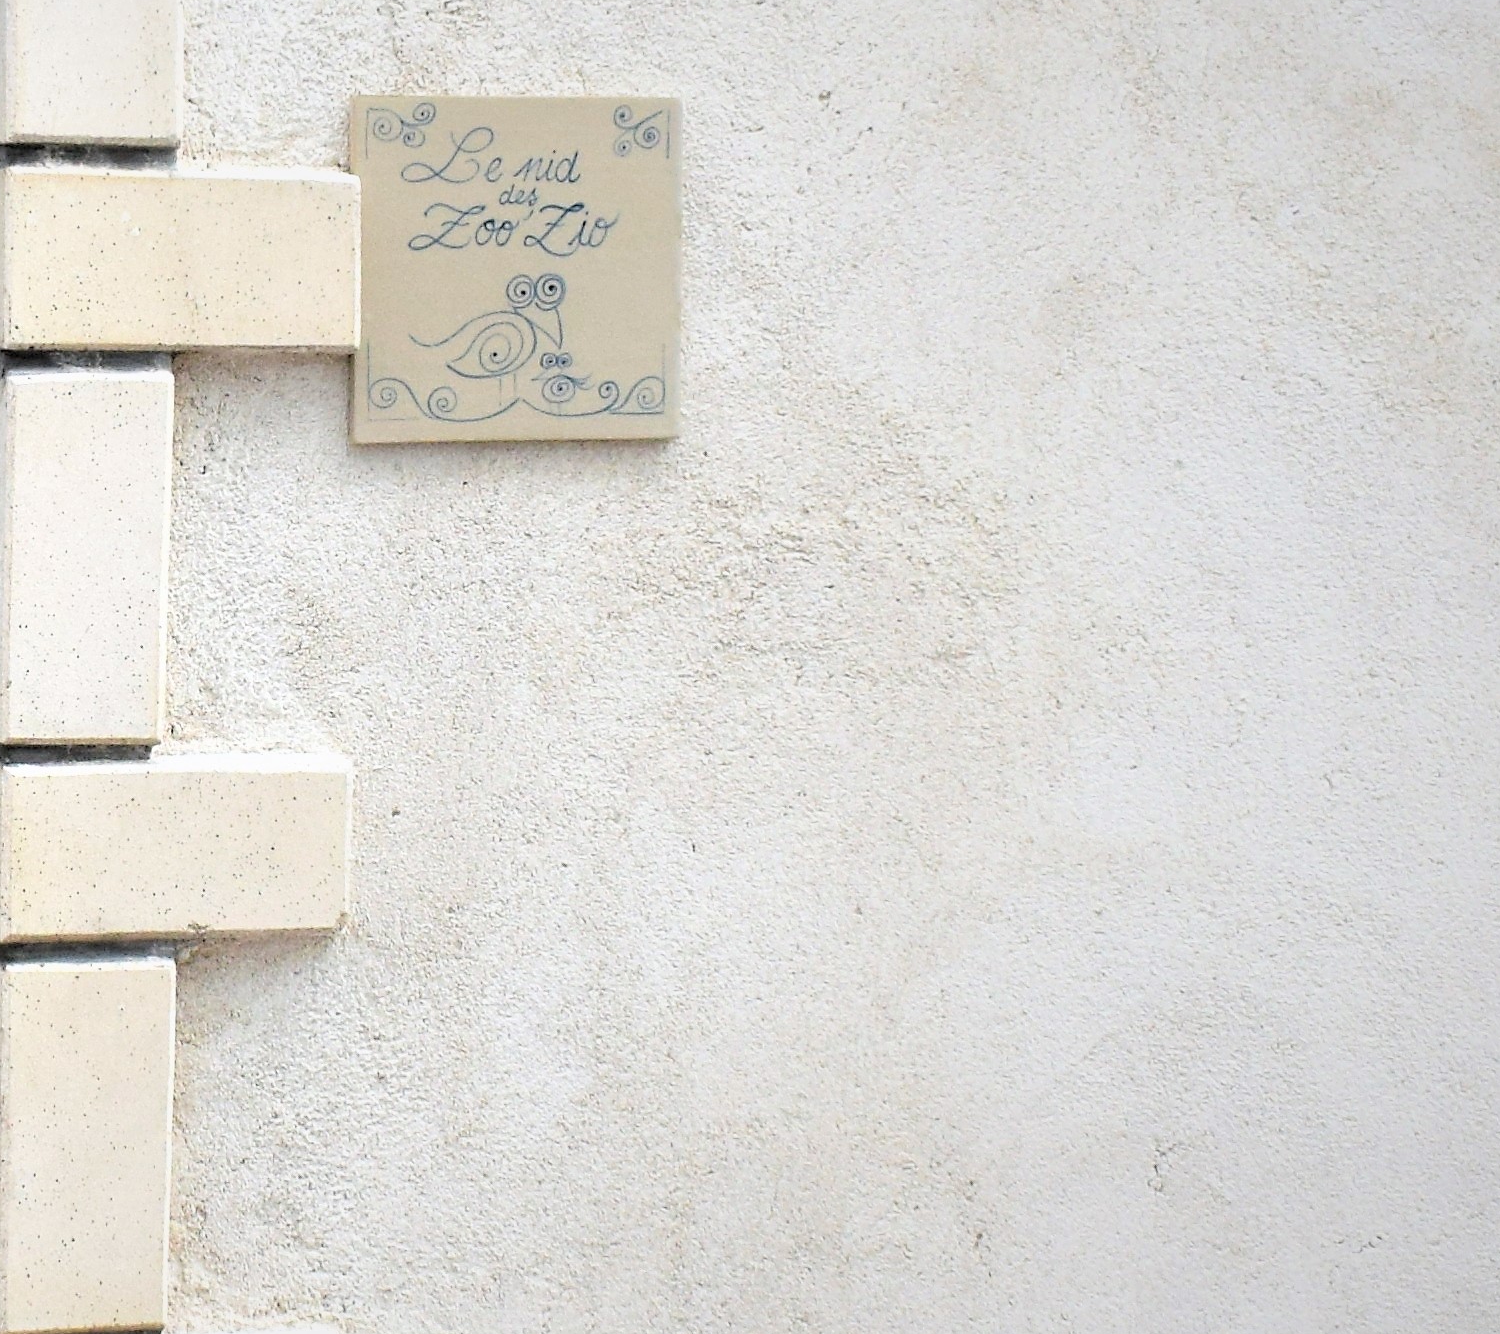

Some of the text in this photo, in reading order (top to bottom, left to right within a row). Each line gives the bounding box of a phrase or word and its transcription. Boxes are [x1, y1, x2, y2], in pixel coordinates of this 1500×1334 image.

[401, 126, 580, 183] Le nid
[499, 184, 539, 206] des
